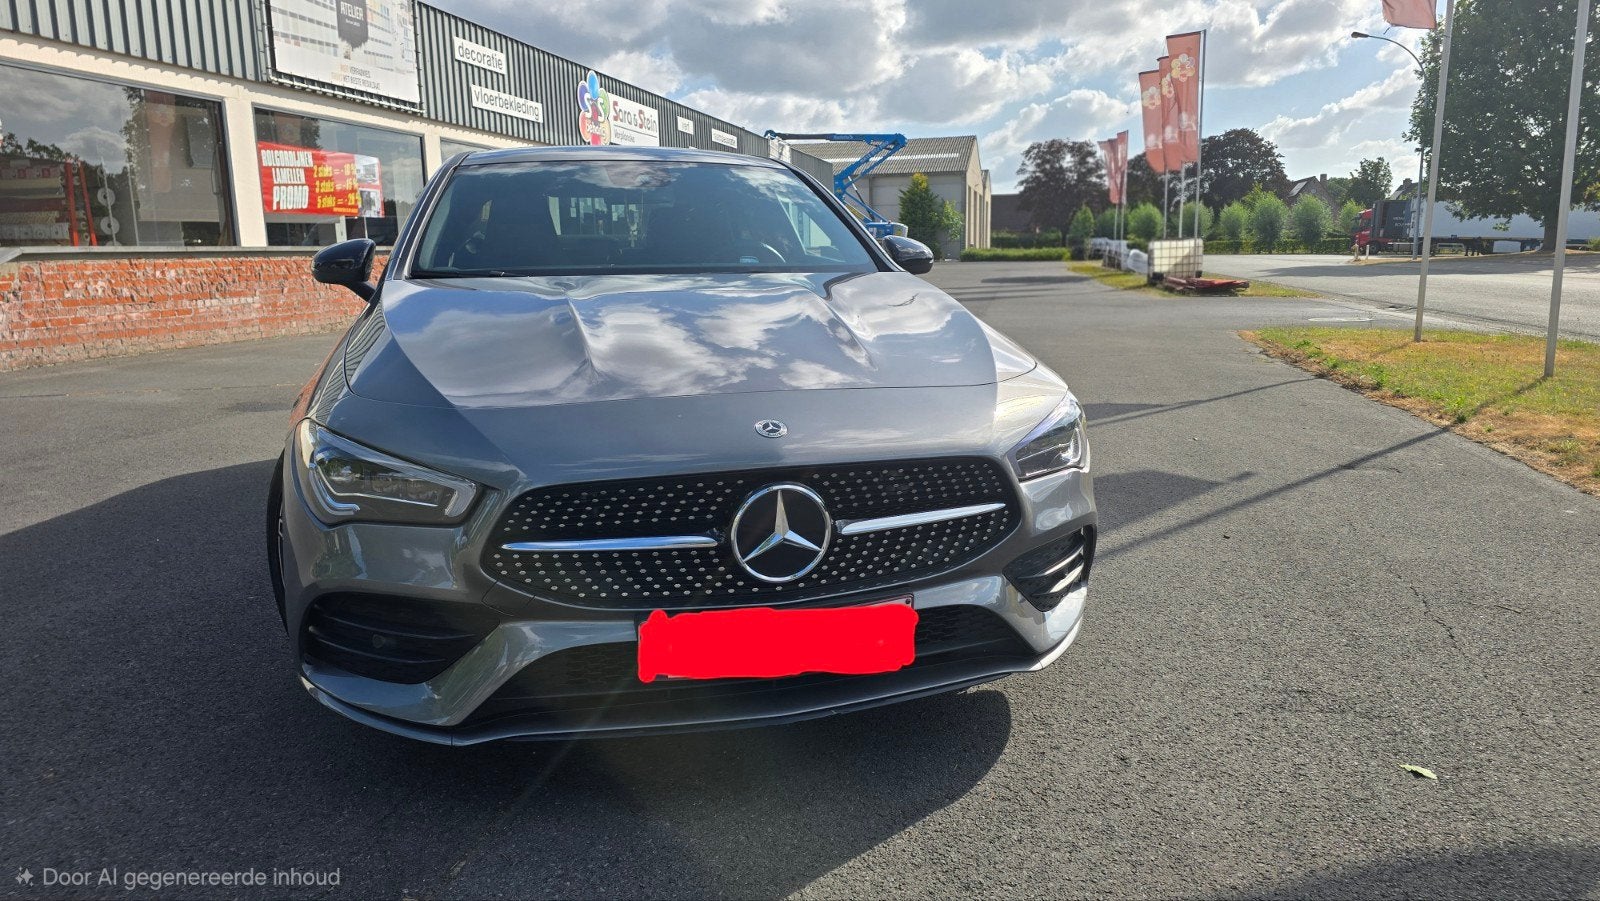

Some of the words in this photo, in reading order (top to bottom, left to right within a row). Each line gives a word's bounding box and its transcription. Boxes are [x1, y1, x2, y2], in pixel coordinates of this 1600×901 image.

[457, 41, 503, 70] decoratie
[473, 88, 540, 120] vloerbekleding
[612, 100, 632, 126] Sara
[638, 109, 658, 133] Stein
[272, 167, 306, 184] LAMELLEN
[273, 185, 309, 210] PROMO
